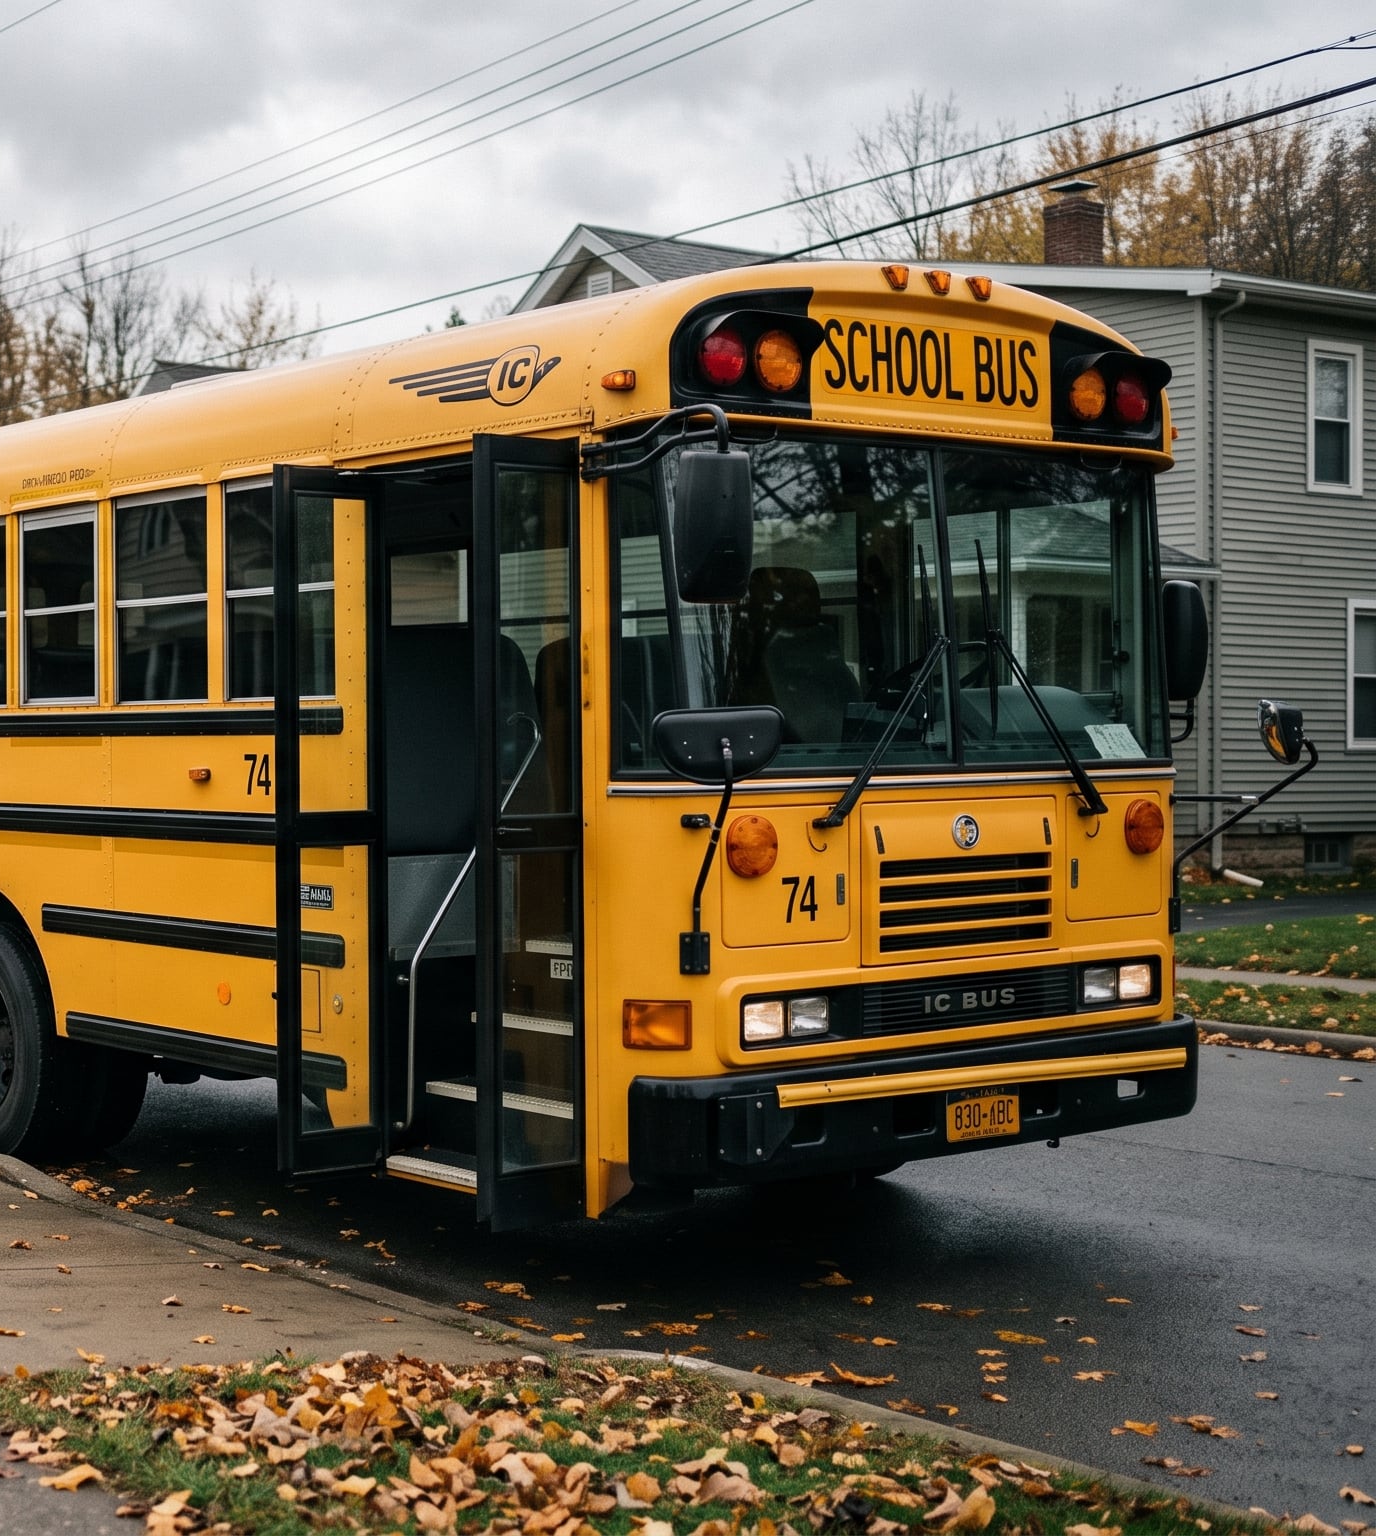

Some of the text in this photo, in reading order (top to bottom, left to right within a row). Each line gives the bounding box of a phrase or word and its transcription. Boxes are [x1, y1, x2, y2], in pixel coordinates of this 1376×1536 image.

[497, 357, 531, 392] IC
[824, 318, 1039, 408] SCHOOL BUS
[244, 754, 272, 796] 74
[781, 875, 819, 924] 74
[924, 987, 1016, 1014] IC BUS
